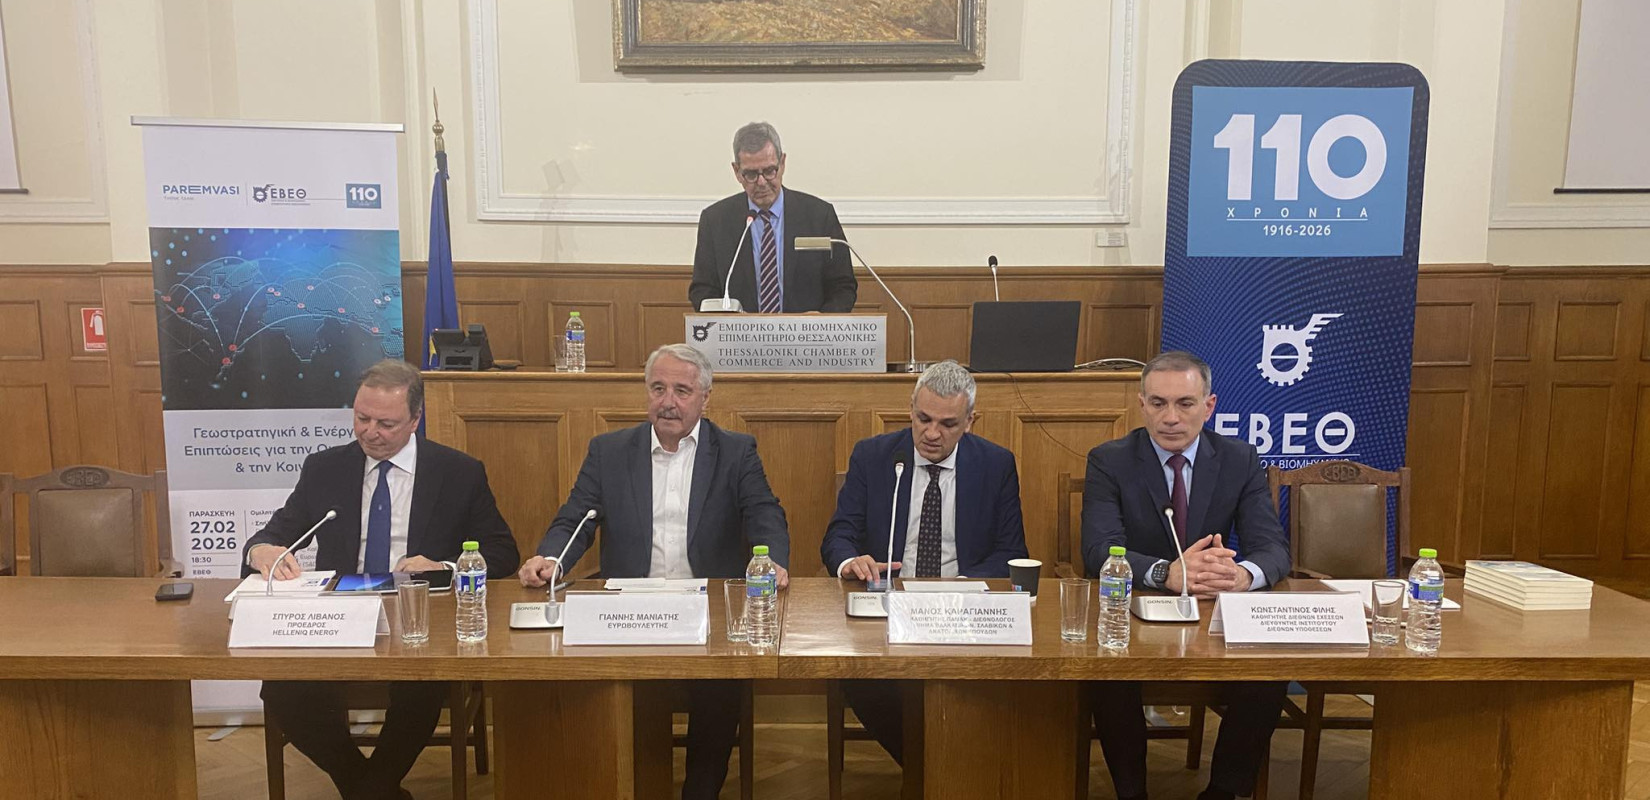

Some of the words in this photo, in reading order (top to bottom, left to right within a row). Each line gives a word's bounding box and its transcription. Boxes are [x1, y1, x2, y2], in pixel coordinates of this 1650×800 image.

[1213, 113, 1388, 201] 110
[162, 185, 240, 195] PAREMVASI
[349, 187, 378, 201] 110
[1263, 224, 1331, 236] 1916-2026
[718, 323, 775, 332] ΕΜΠΟΡΙΚΟ
[778, 323, 797, 332] ΚΑΙ
[801, 323, 877, 332] ΒΙΟΜΗΧΑΝΙΚΟ
[718, 334, 796, 342] ΕΠΙΜΕΛΗΤΗΡΙΟ
[797, 334, 877, 342] ΘΕΣΣΑΛΟΝΙΚΗΣ
[718, 348, 798, 357] THESSALONIKI
[803, 348, 857, 357] CHAMBER
[862, 348, 876, 357] OF
[718, 358, 783, 367] COMMERCE
[789, 358, 813, 367] AND
[818, 358, 876, 367] INDUSTRY
[193, 426, 296, 440] Γεωστρατηγική
[300, 427, 310, 437] &
[184, 445, 261, 457] Επιπτώσεις
[265, 446, 287, 457] για
[290, 445, 312, 455] την
[235, 462, 245, 473] &
[249, 463, 271, 473] την
[190, 520, 236, 534] 27.02
[191, 537, 237, 550] 2026
[598, 613, 635, 621] ΓΙΑΝΝΗΣ
[636, 613, 680, 621] ΜΑΝΙΑΤΗΣ
